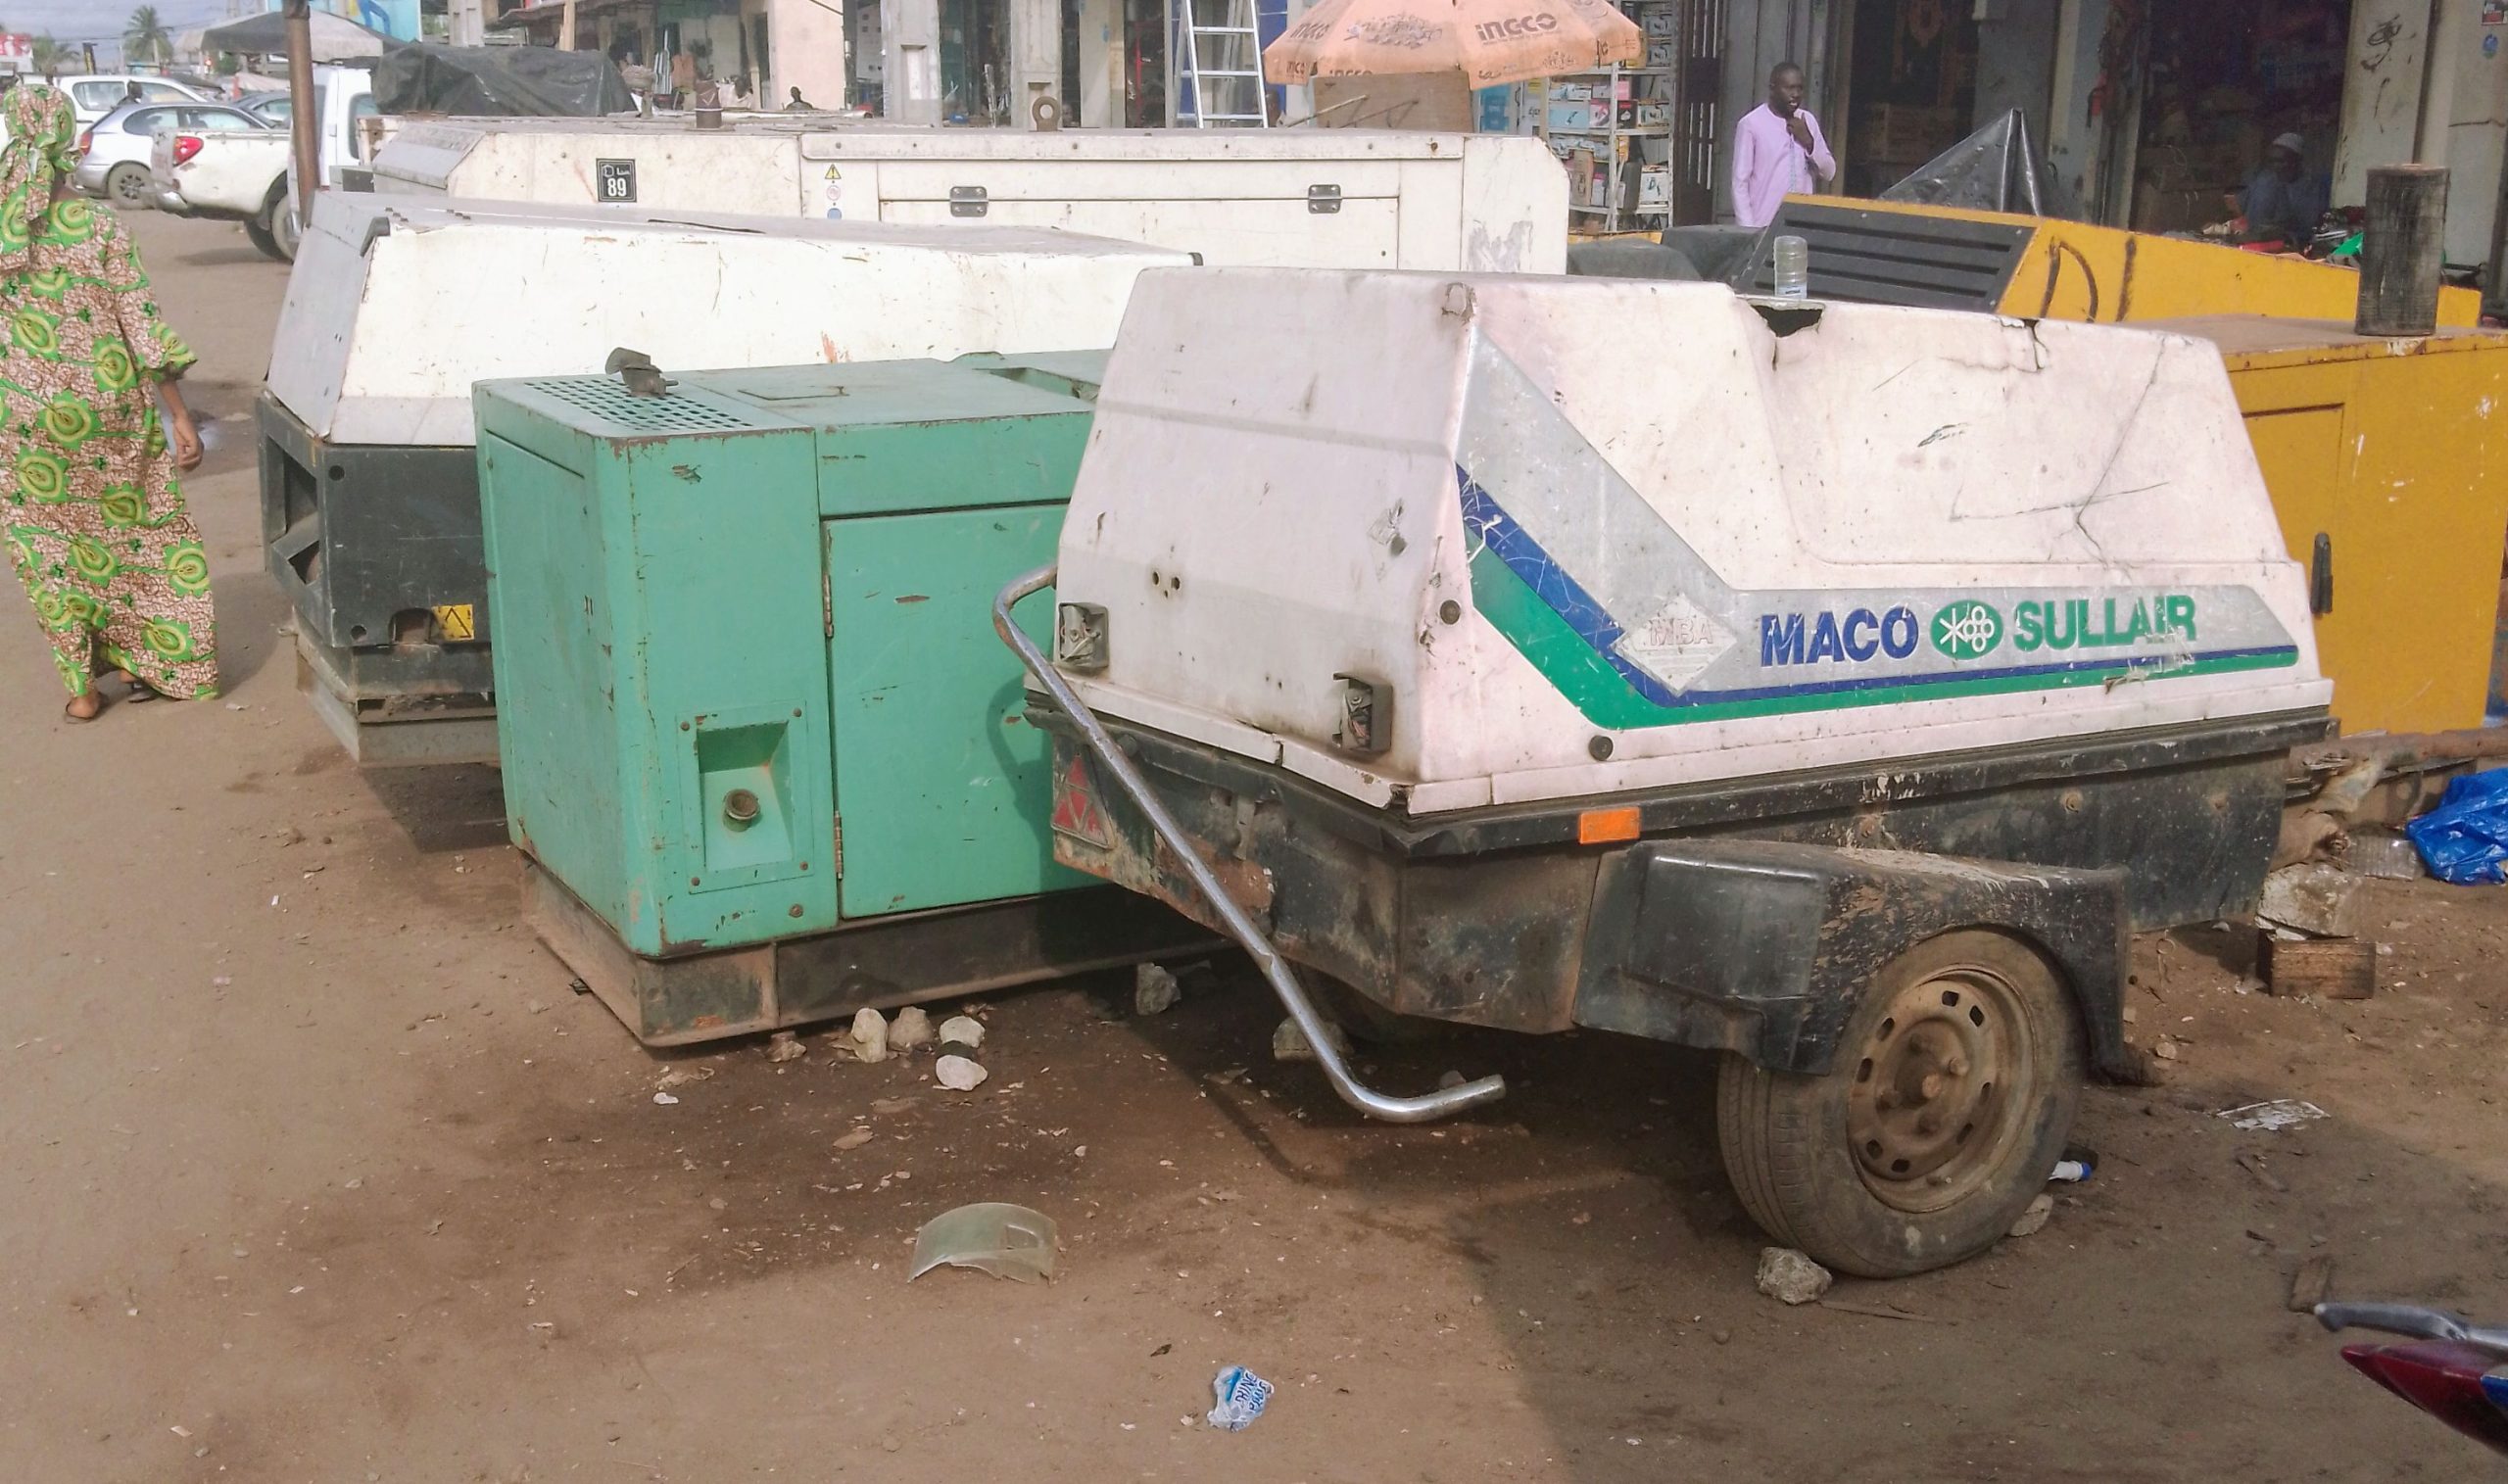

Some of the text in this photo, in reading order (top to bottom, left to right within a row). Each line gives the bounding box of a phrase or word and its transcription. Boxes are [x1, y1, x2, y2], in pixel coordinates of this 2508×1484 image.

[607, 177, 627, 197] 89
[1760, 605, 1919, 667] MACO
[2013, 595, 2197, 651] SULLAIR
